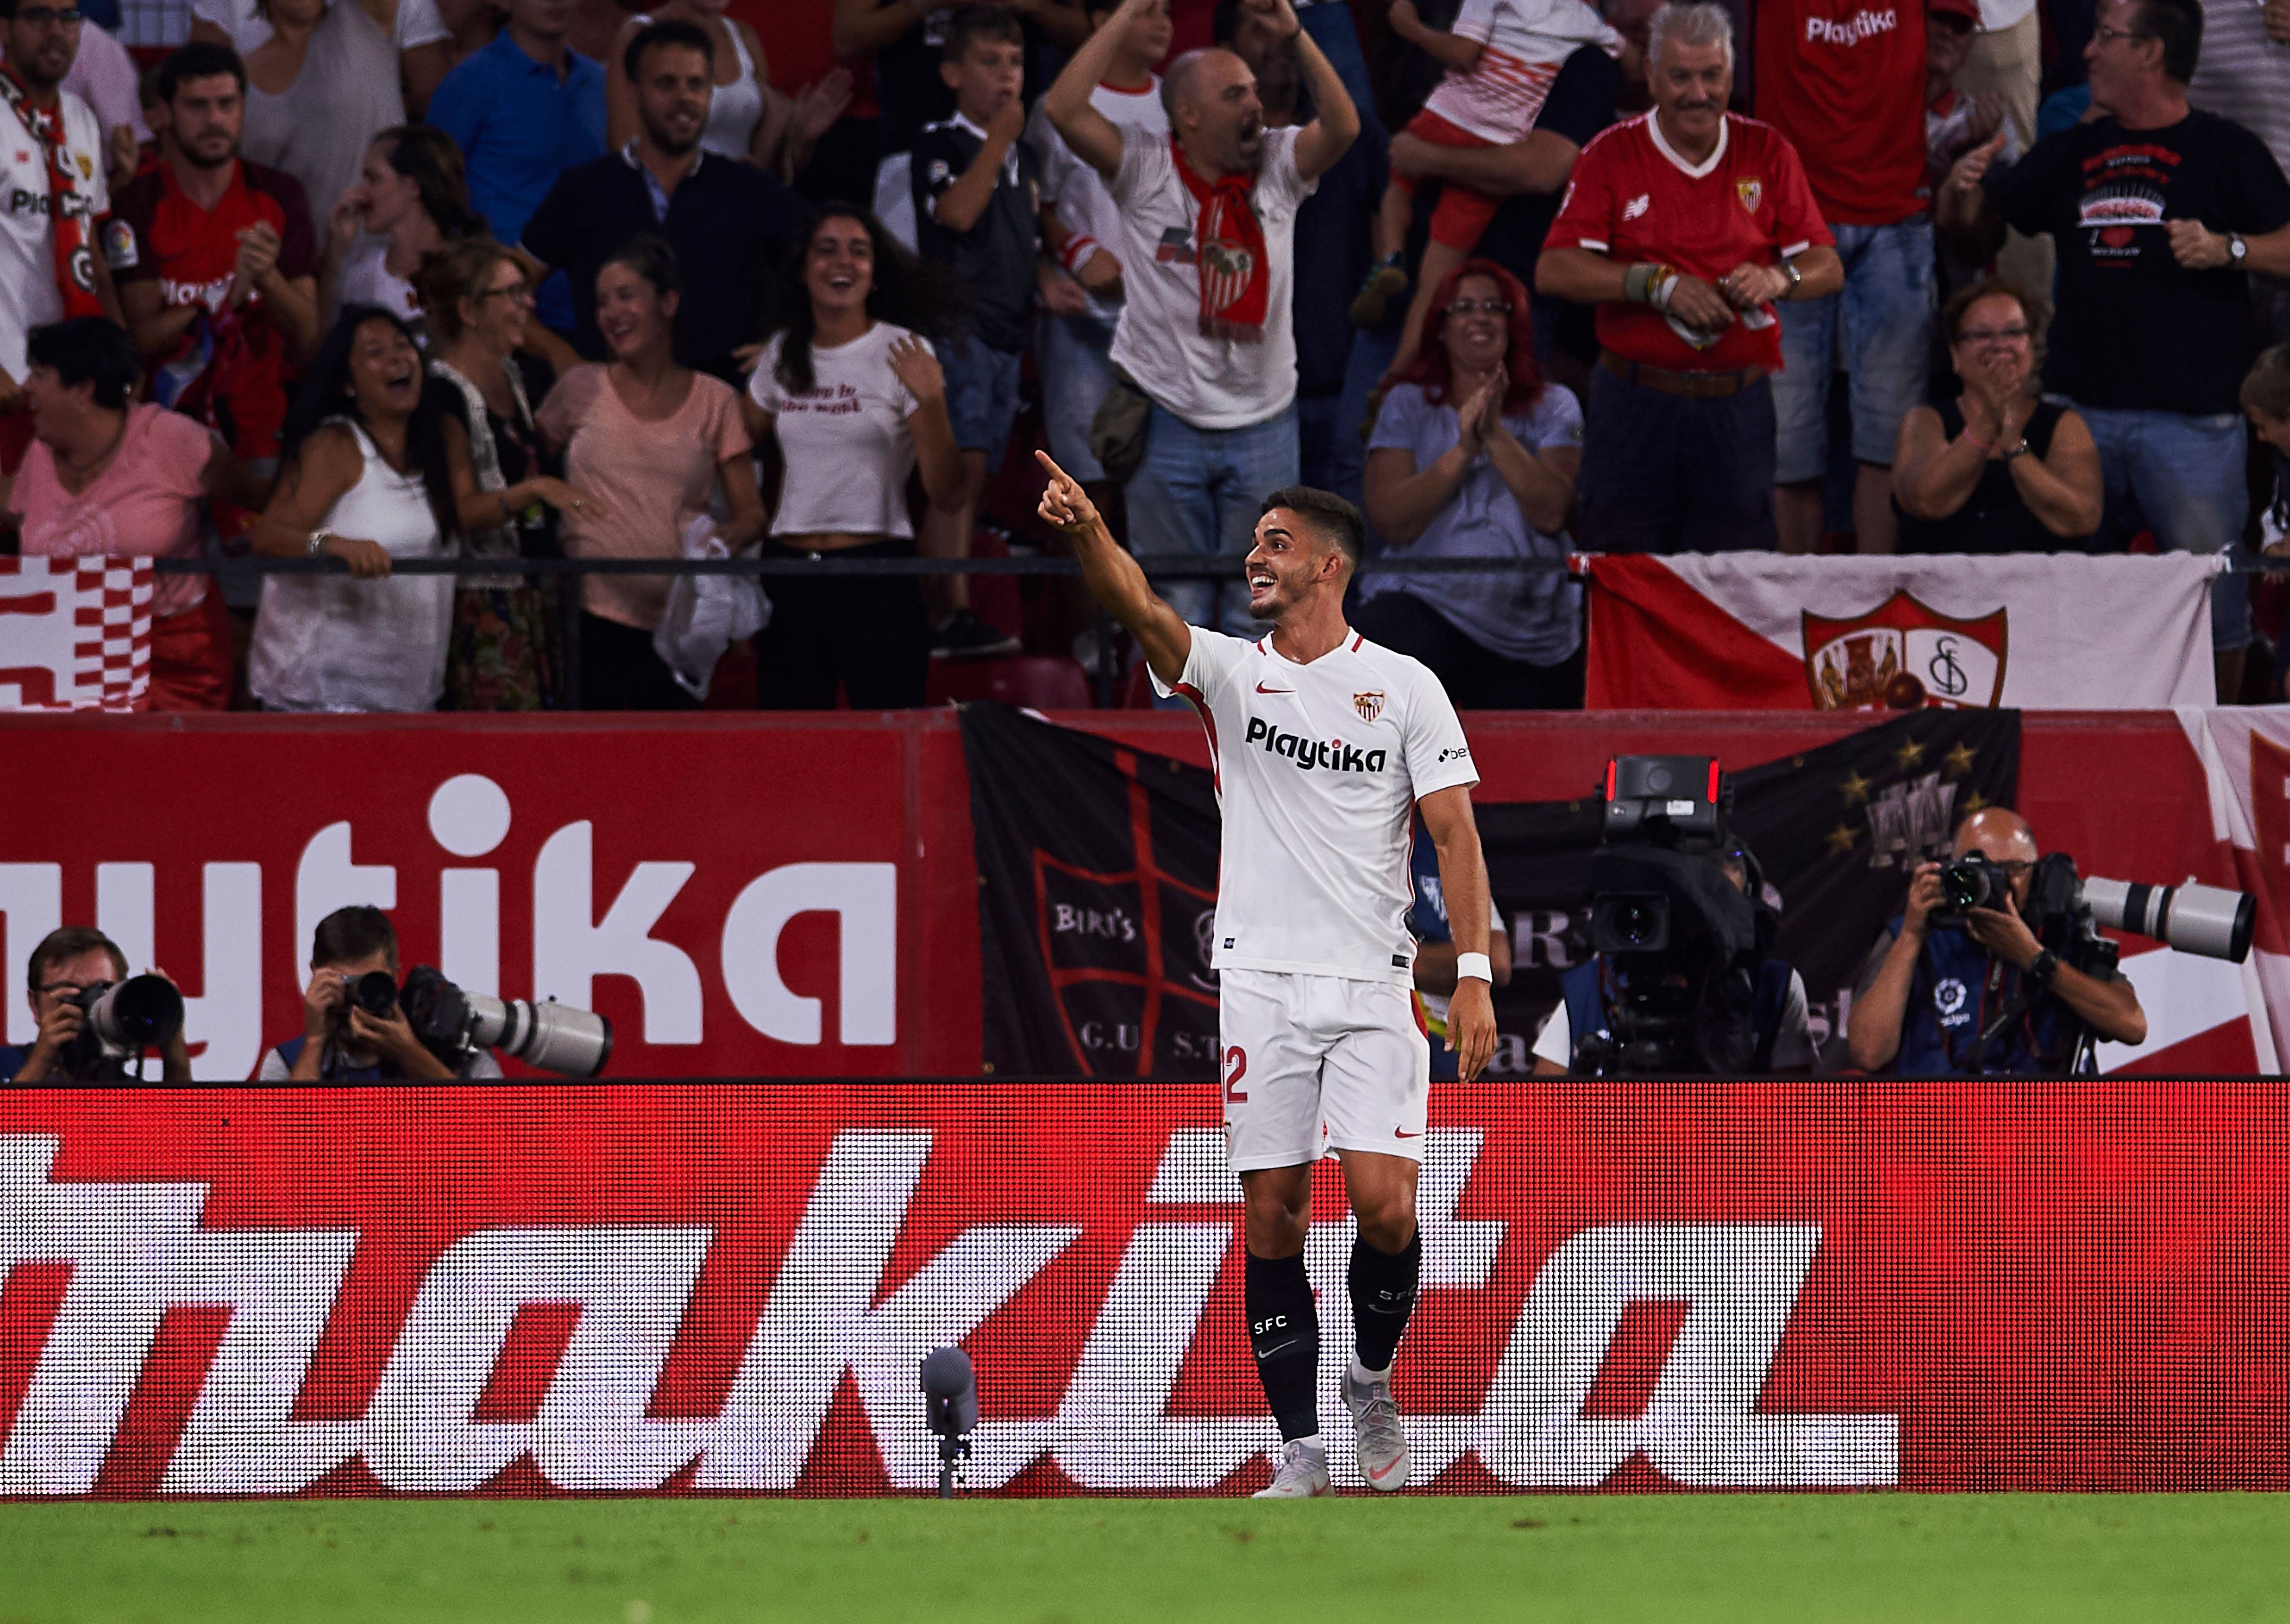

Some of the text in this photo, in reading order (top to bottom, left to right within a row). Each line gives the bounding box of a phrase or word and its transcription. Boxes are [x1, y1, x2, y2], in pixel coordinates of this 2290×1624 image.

[1807, 9, 1896, 46] Playtika
[1246, 716, 1386, 772] Playtika
[1449, 748, 1470, 759] be
[1220, 1046, 1248, 1103] 2
[0, 1129, 1899, 1495] makita
[1254, 1315, 1287, 1334] SFC
